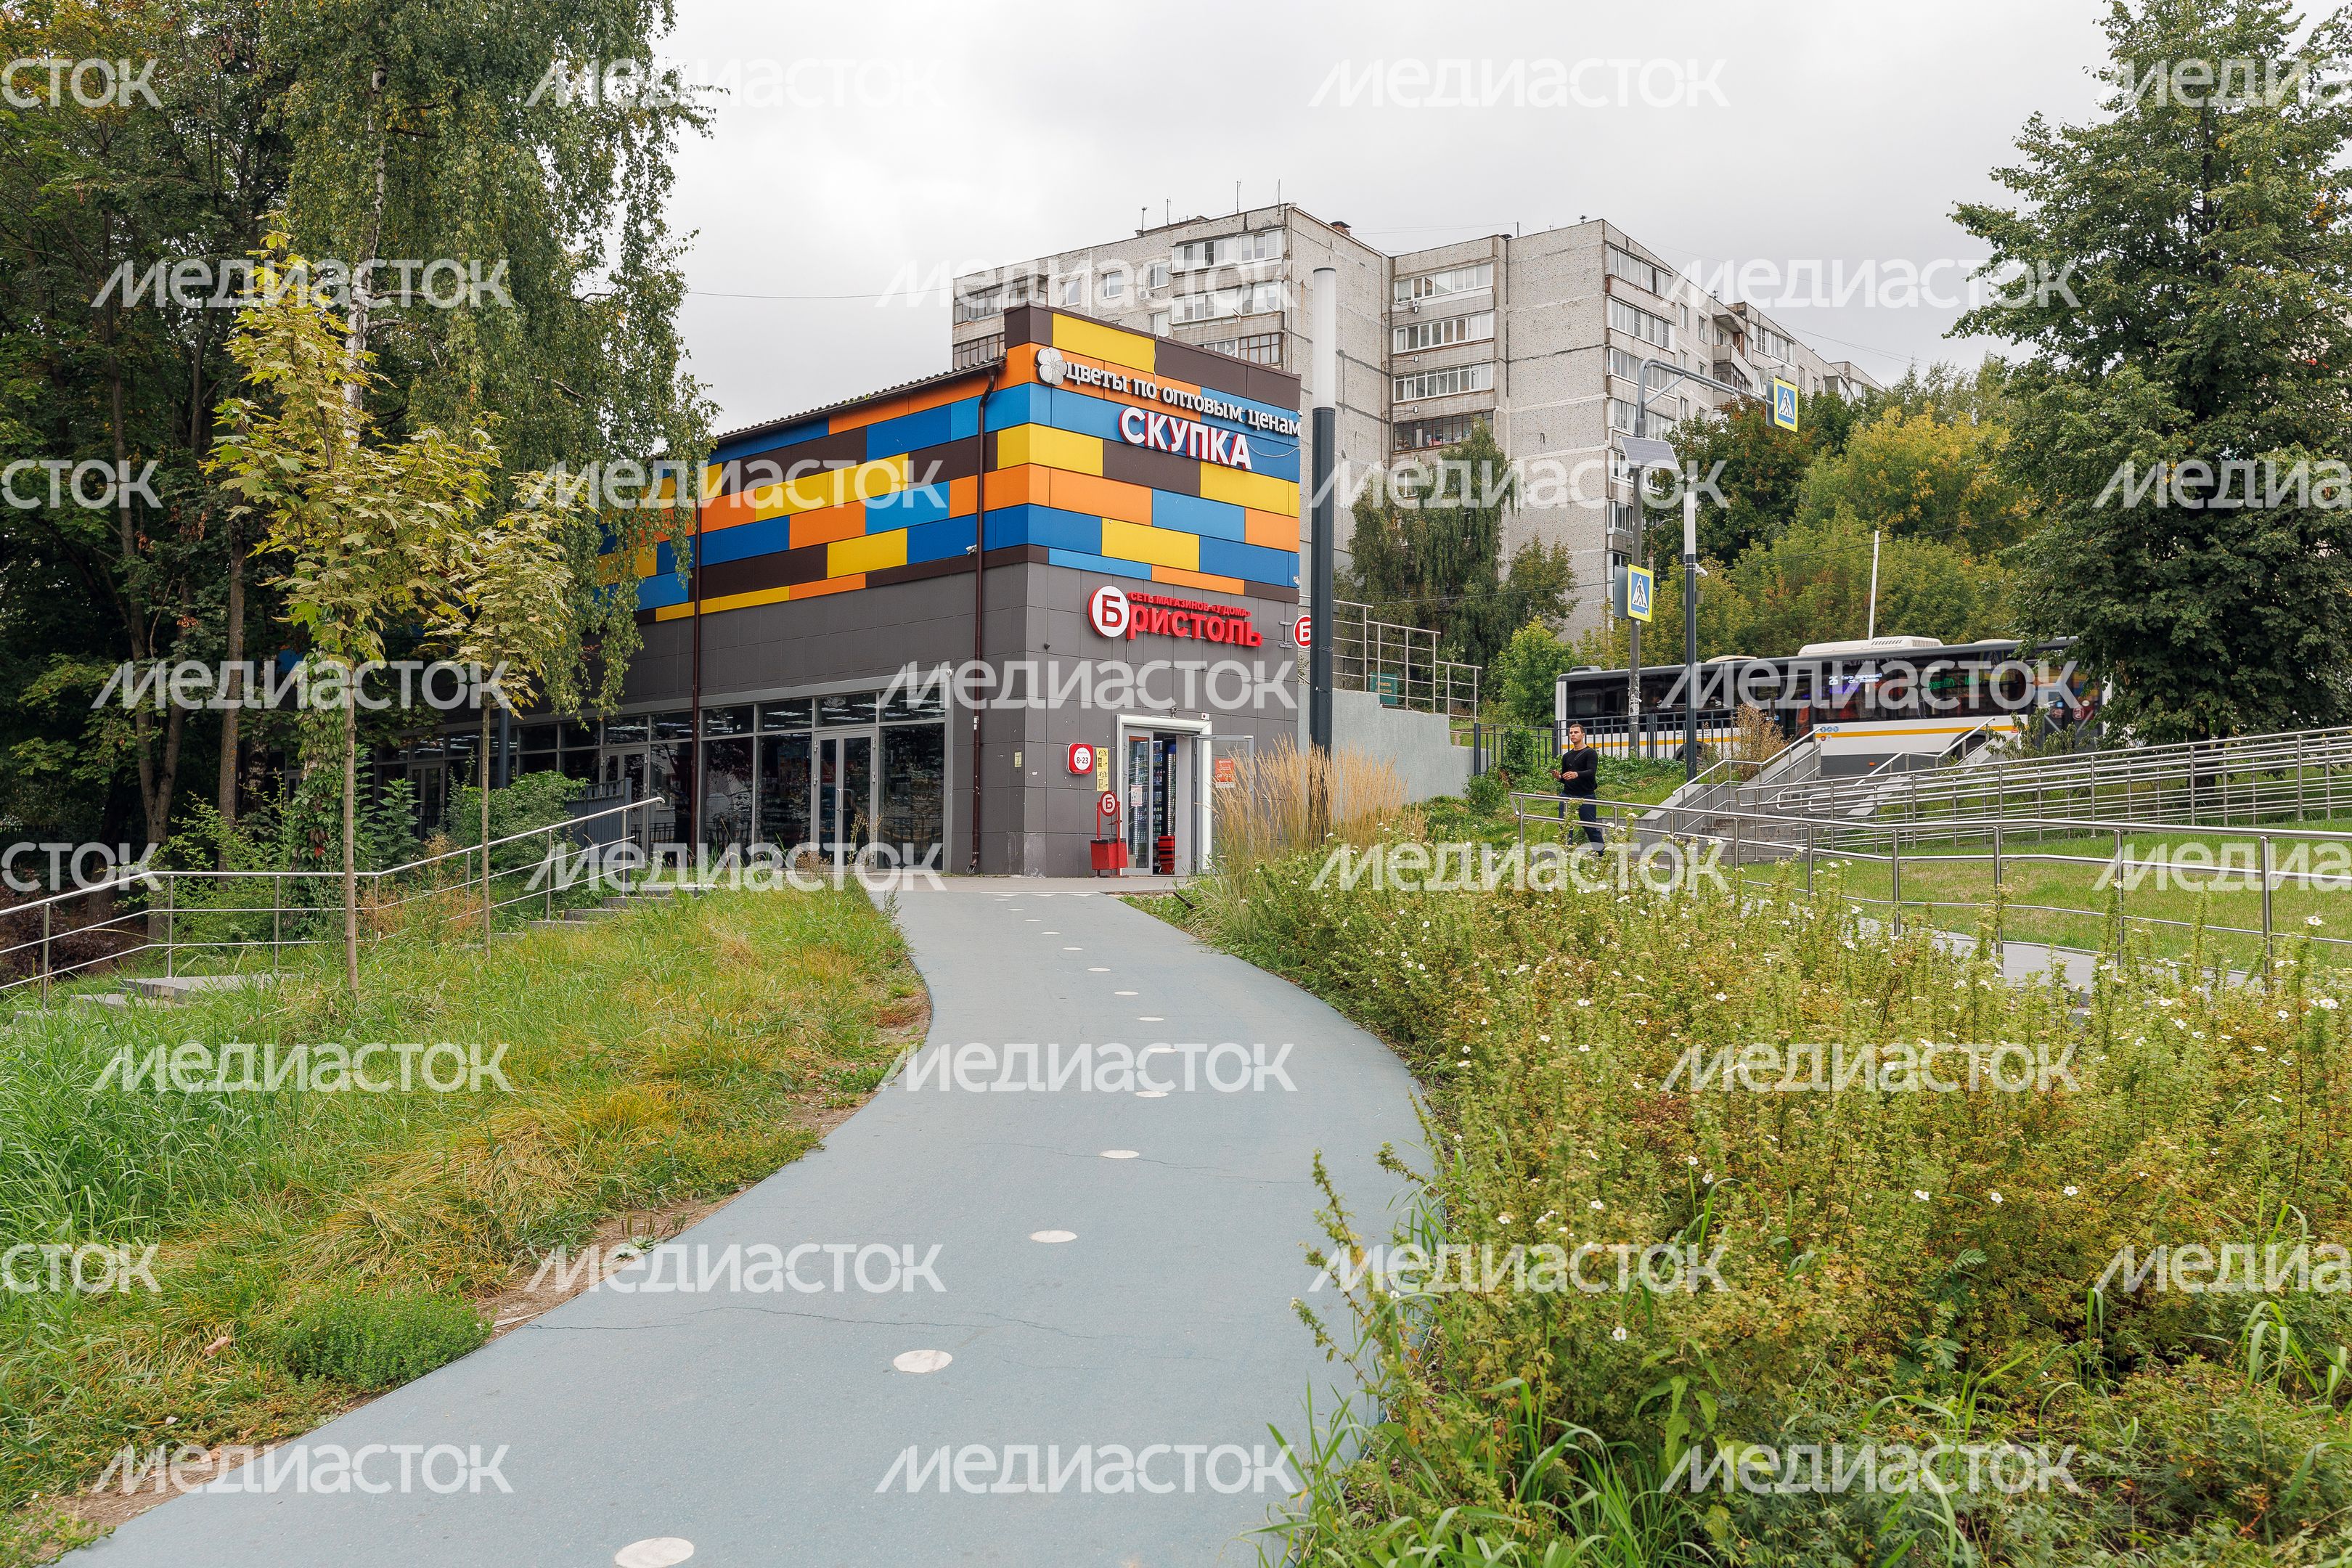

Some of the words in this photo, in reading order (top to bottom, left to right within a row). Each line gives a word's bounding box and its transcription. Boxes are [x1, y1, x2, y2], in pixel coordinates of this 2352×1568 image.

[1119, 407, 1253, 470] СКУПКА
[1129, 592, 1154, 604] СЕТЬ
[1155, 595, 1209, 611] МАГАЗИНОВ
[1299, 621, 1311, 642] Б
[1105, 797, 1113, 809] Б
